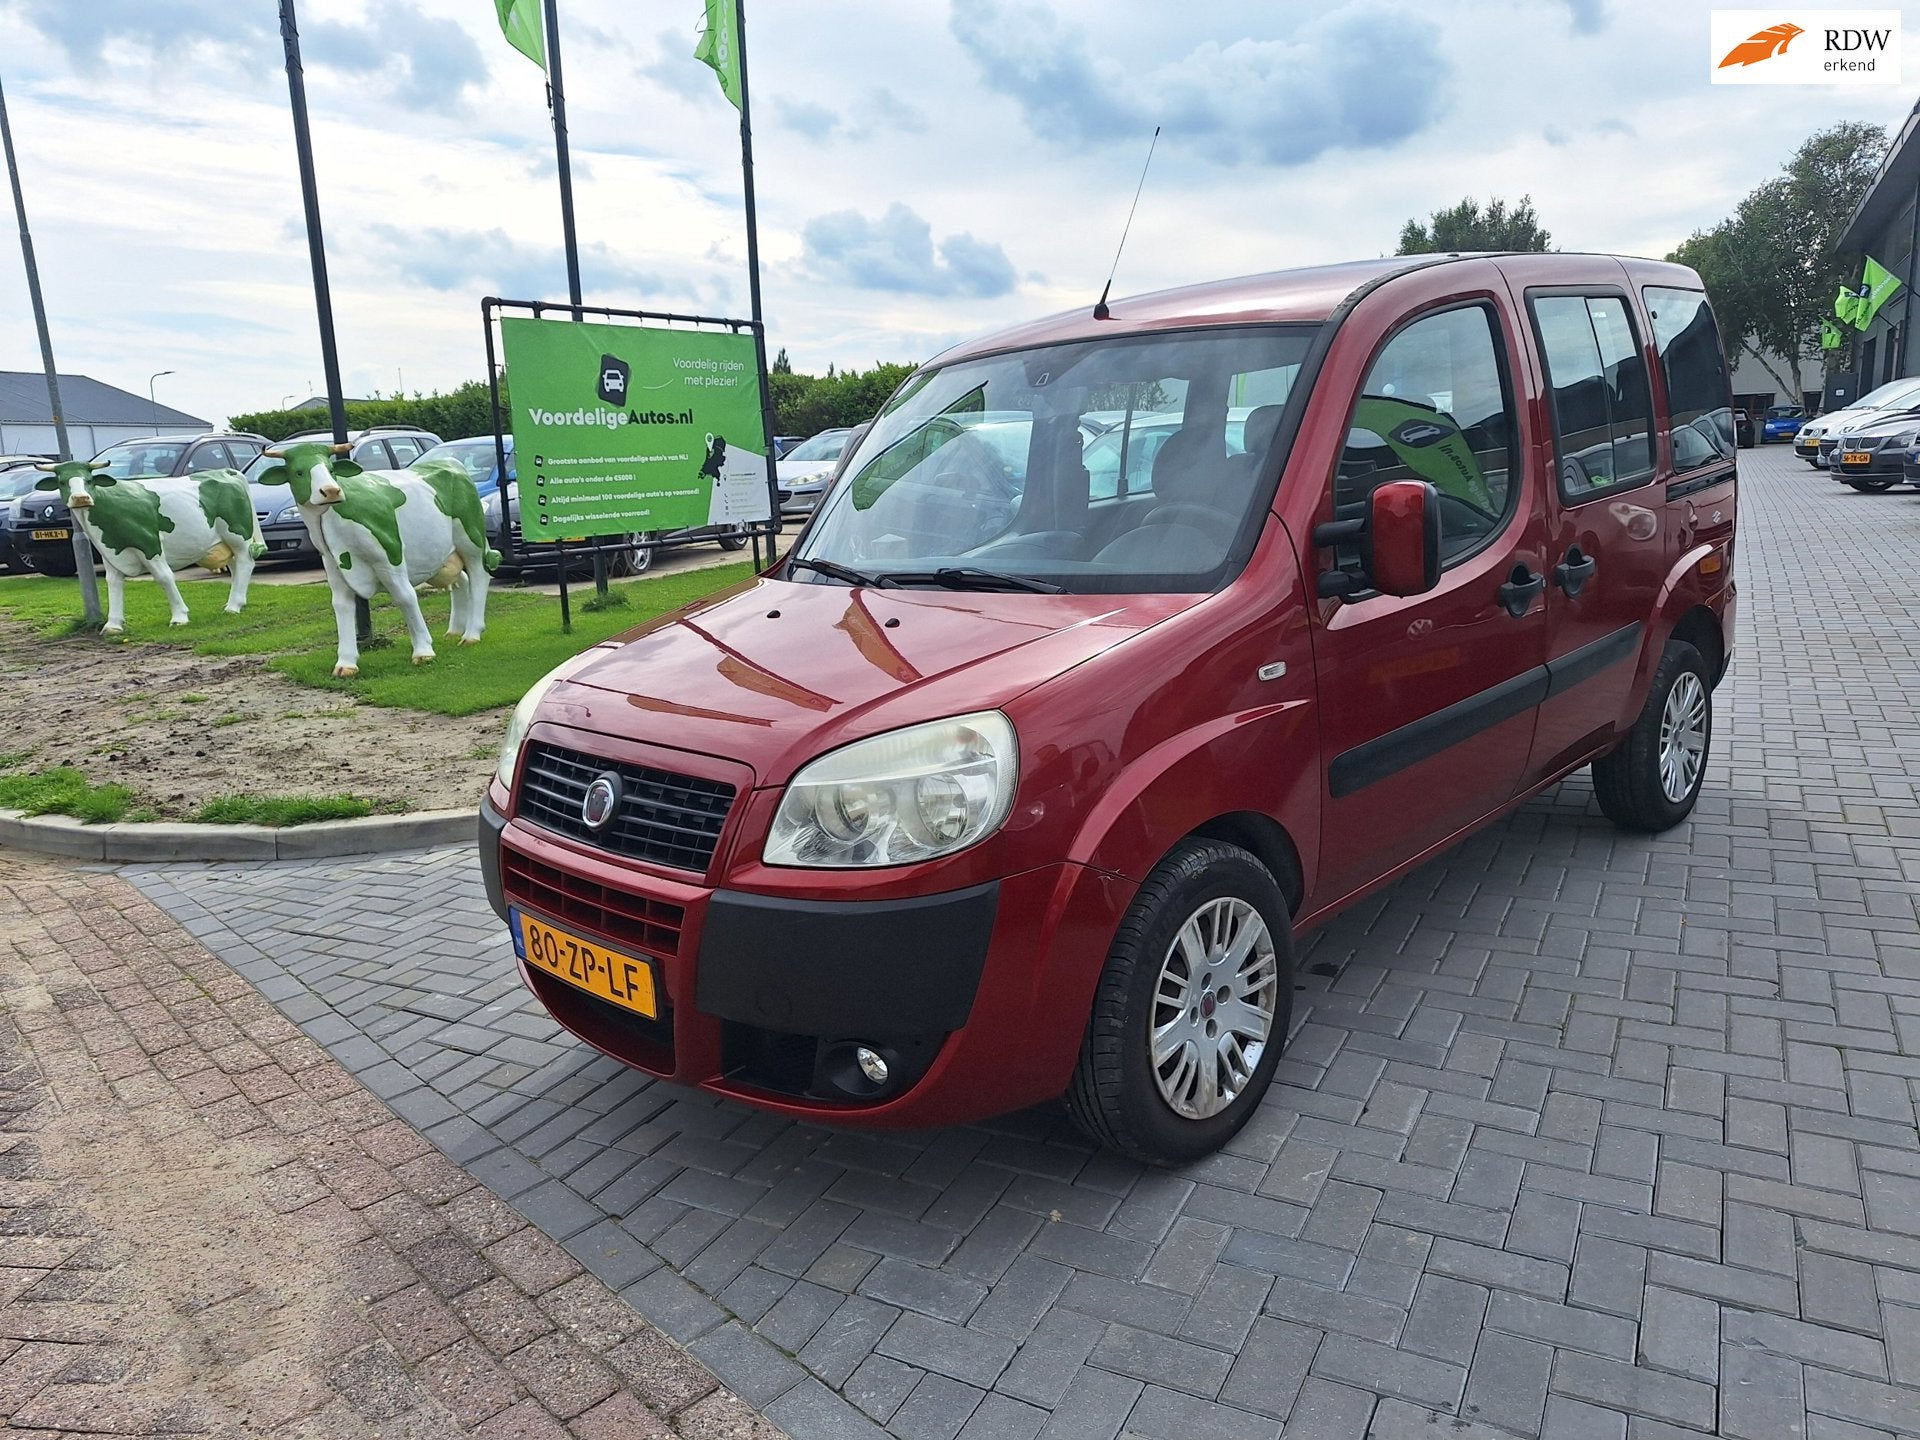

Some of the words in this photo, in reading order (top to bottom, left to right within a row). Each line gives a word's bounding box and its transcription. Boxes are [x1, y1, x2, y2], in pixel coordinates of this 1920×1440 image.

[672, 357, 718, 372] Voordelig
[719, 359, 745, 373] rijden
[684, 376, 704, 386] met
[705, 375, 738, 388] plezier!
[528, 407, 694, 430] VoordeligeAutos.nl
[578, 456, 604, 464] aanbod
[616, 455, 649, 464] voordelige
[585, 475, 604, 483] onder
[551, 496, 570, 504] Altijd
[570, 494, 602, 502] minimaal
[613, 491, 645, 500] voordelige
[645, 490, 664, 498] auto's
[552, 514, 584, 523] Dagelijks
[585, 511, 620, 520] wisselende
[529, 924, 639, 1001] 80-ZP-LF
